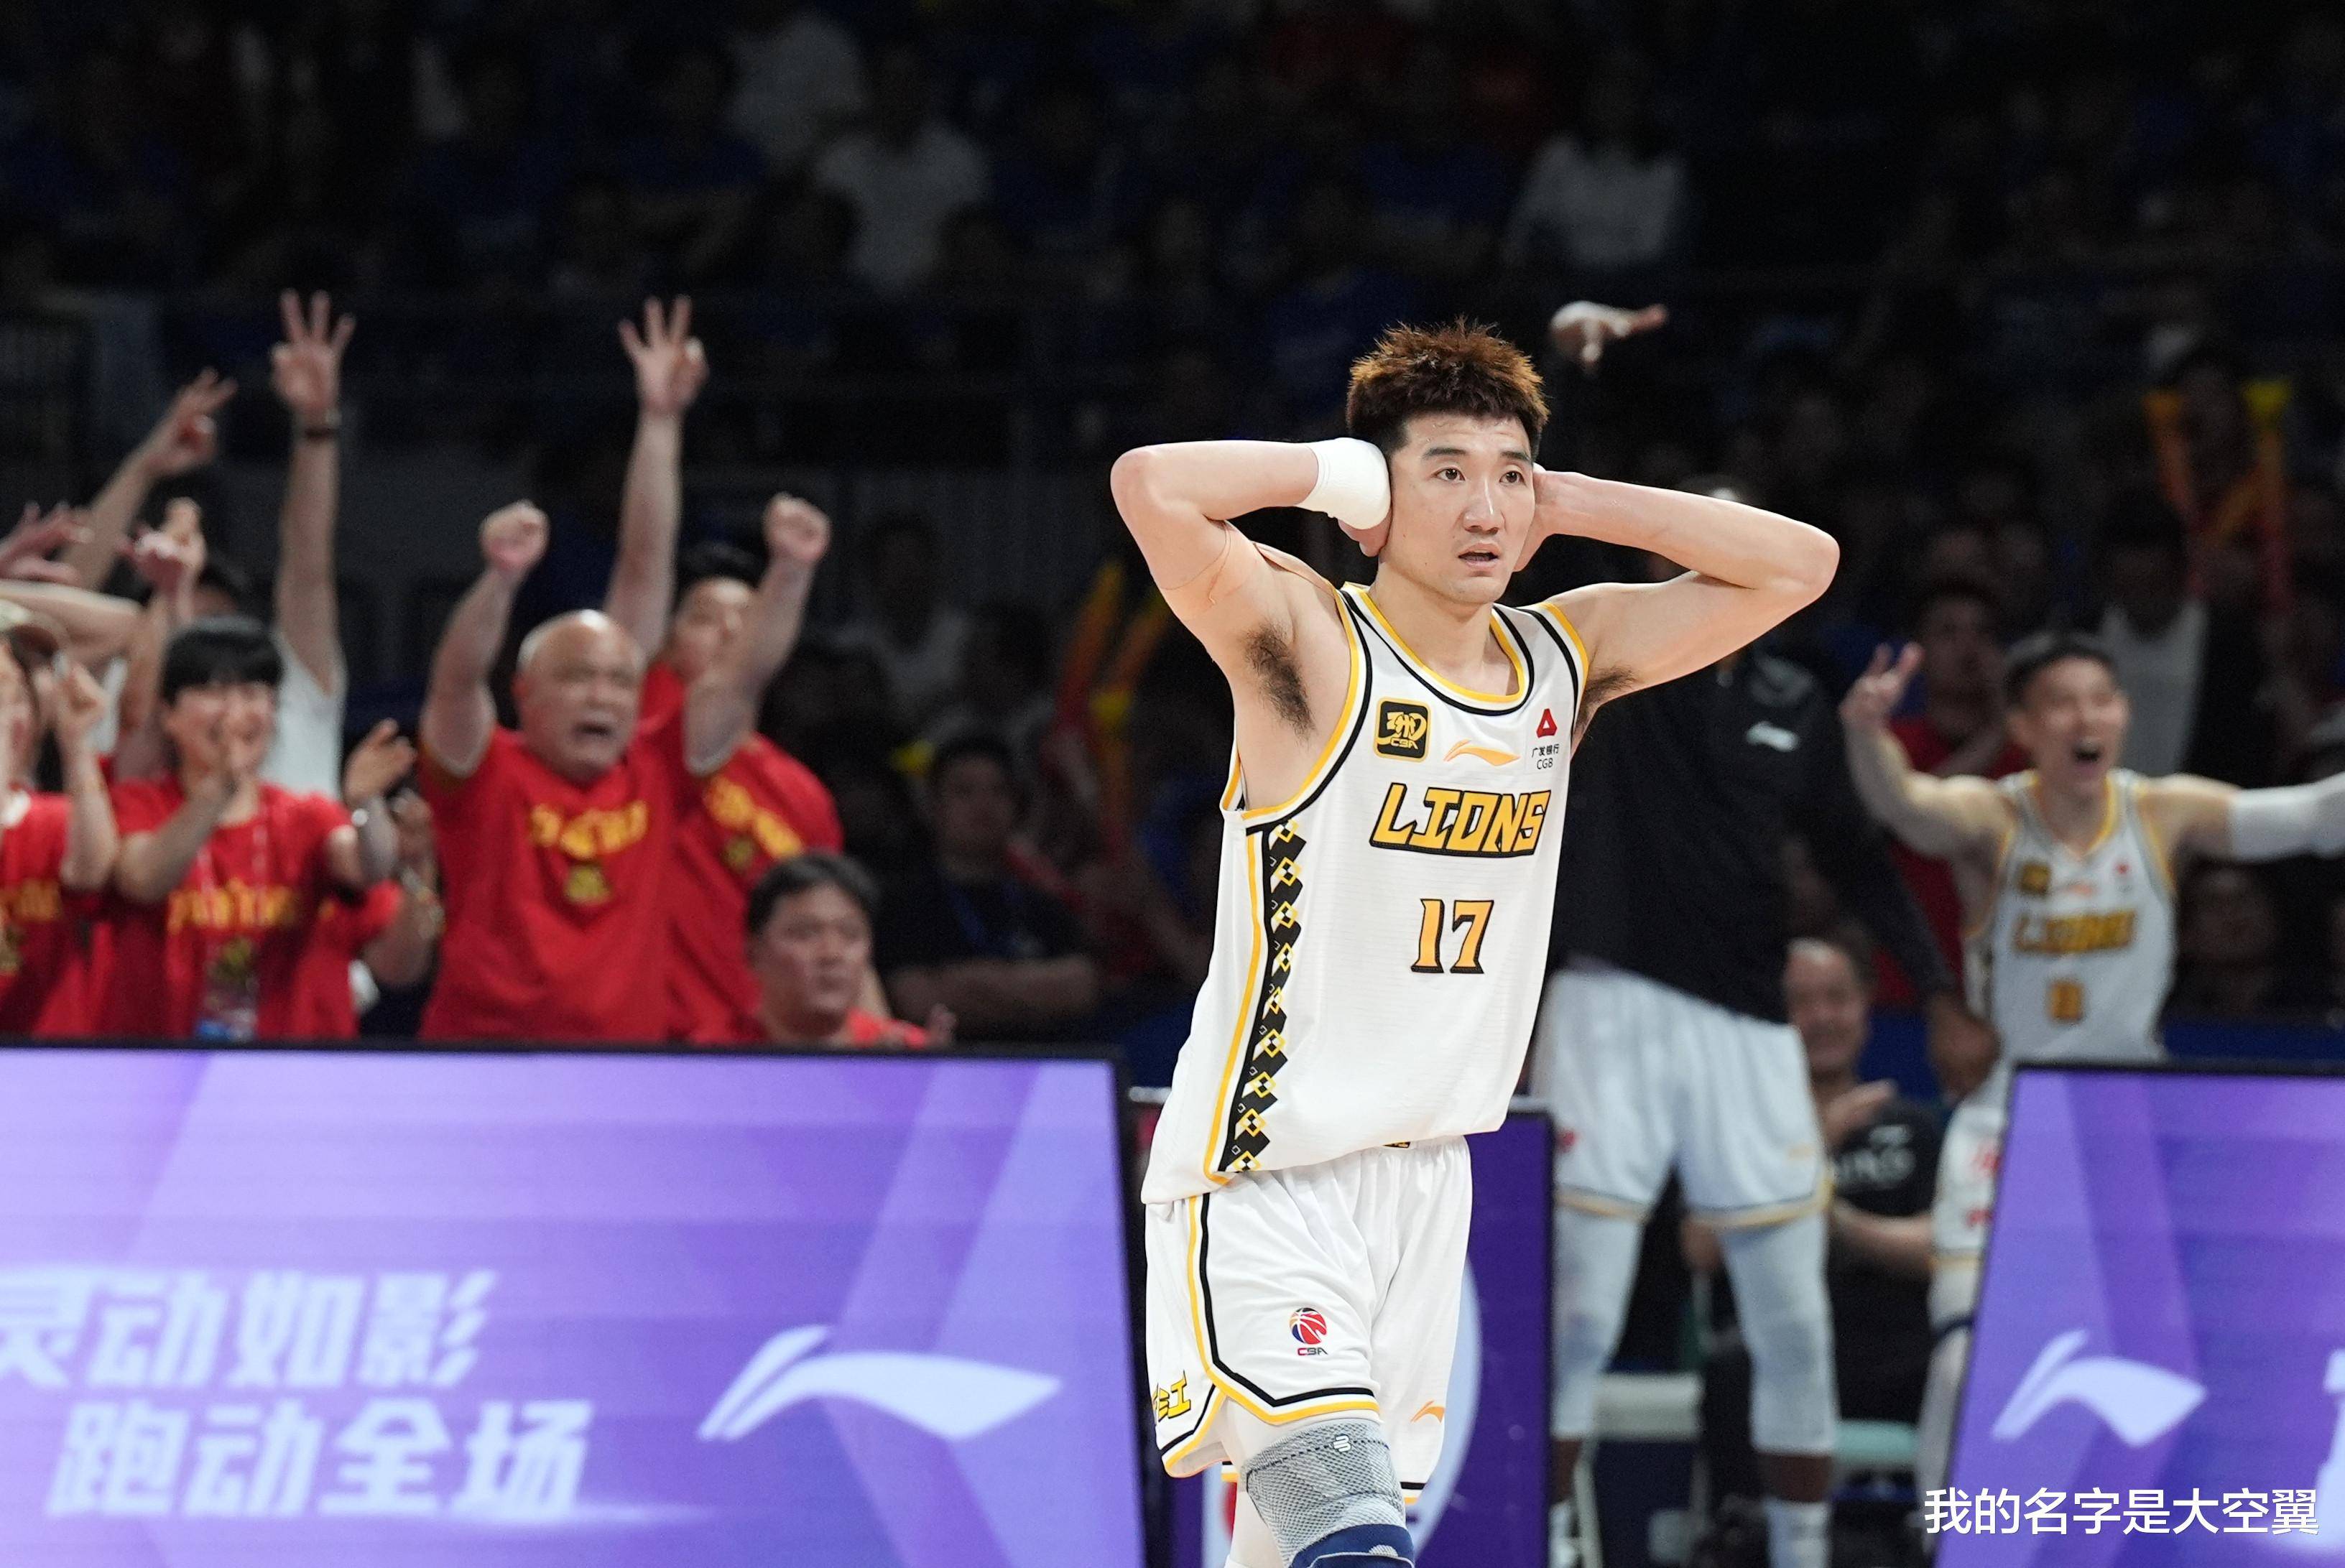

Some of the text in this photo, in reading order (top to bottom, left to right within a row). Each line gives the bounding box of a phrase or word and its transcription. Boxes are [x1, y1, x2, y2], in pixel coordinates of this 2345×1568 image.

[1391, 738, 1418, 750] CBA
[1537, 758, 1553, 770] CGB
[1369, 782, 1551, 858] LIONS
[1410, 898, 1494, 974] 17
[1298, 1347, 1328, 1356] CBA
[1152, 1369, 1191, 1422] 江
[45, 1399, 592, 1521] 跑动全场
